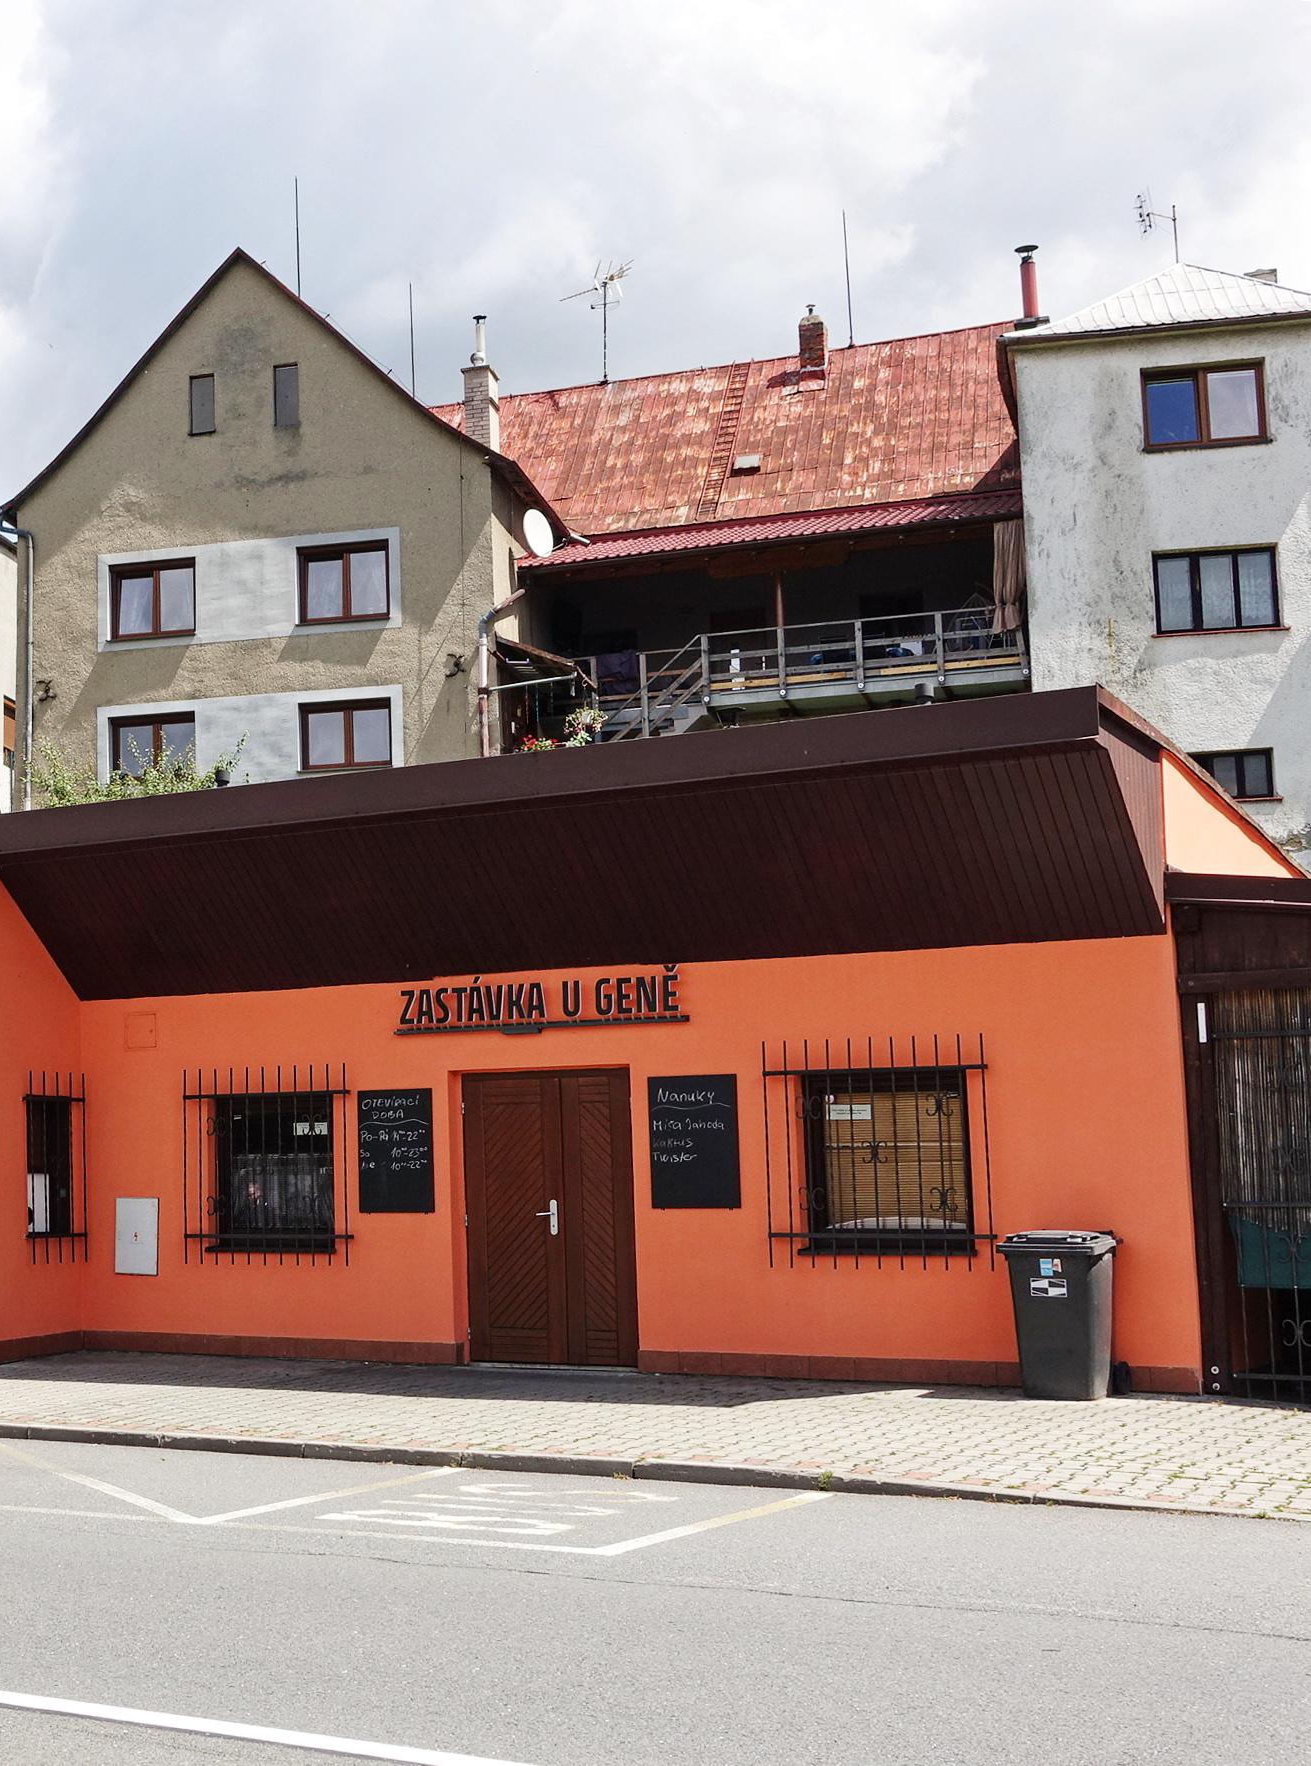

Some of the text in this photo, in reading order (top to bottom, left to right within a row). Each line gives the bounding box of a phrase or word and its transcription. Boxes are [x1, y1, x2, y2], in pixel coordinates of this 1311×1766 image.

[399, 964, 680, 1025] ZASTÁVKA U GENĚ
[657, 1087, 715, 1104] Nanuky
[371, 1109, 404, 1120] DOBA
